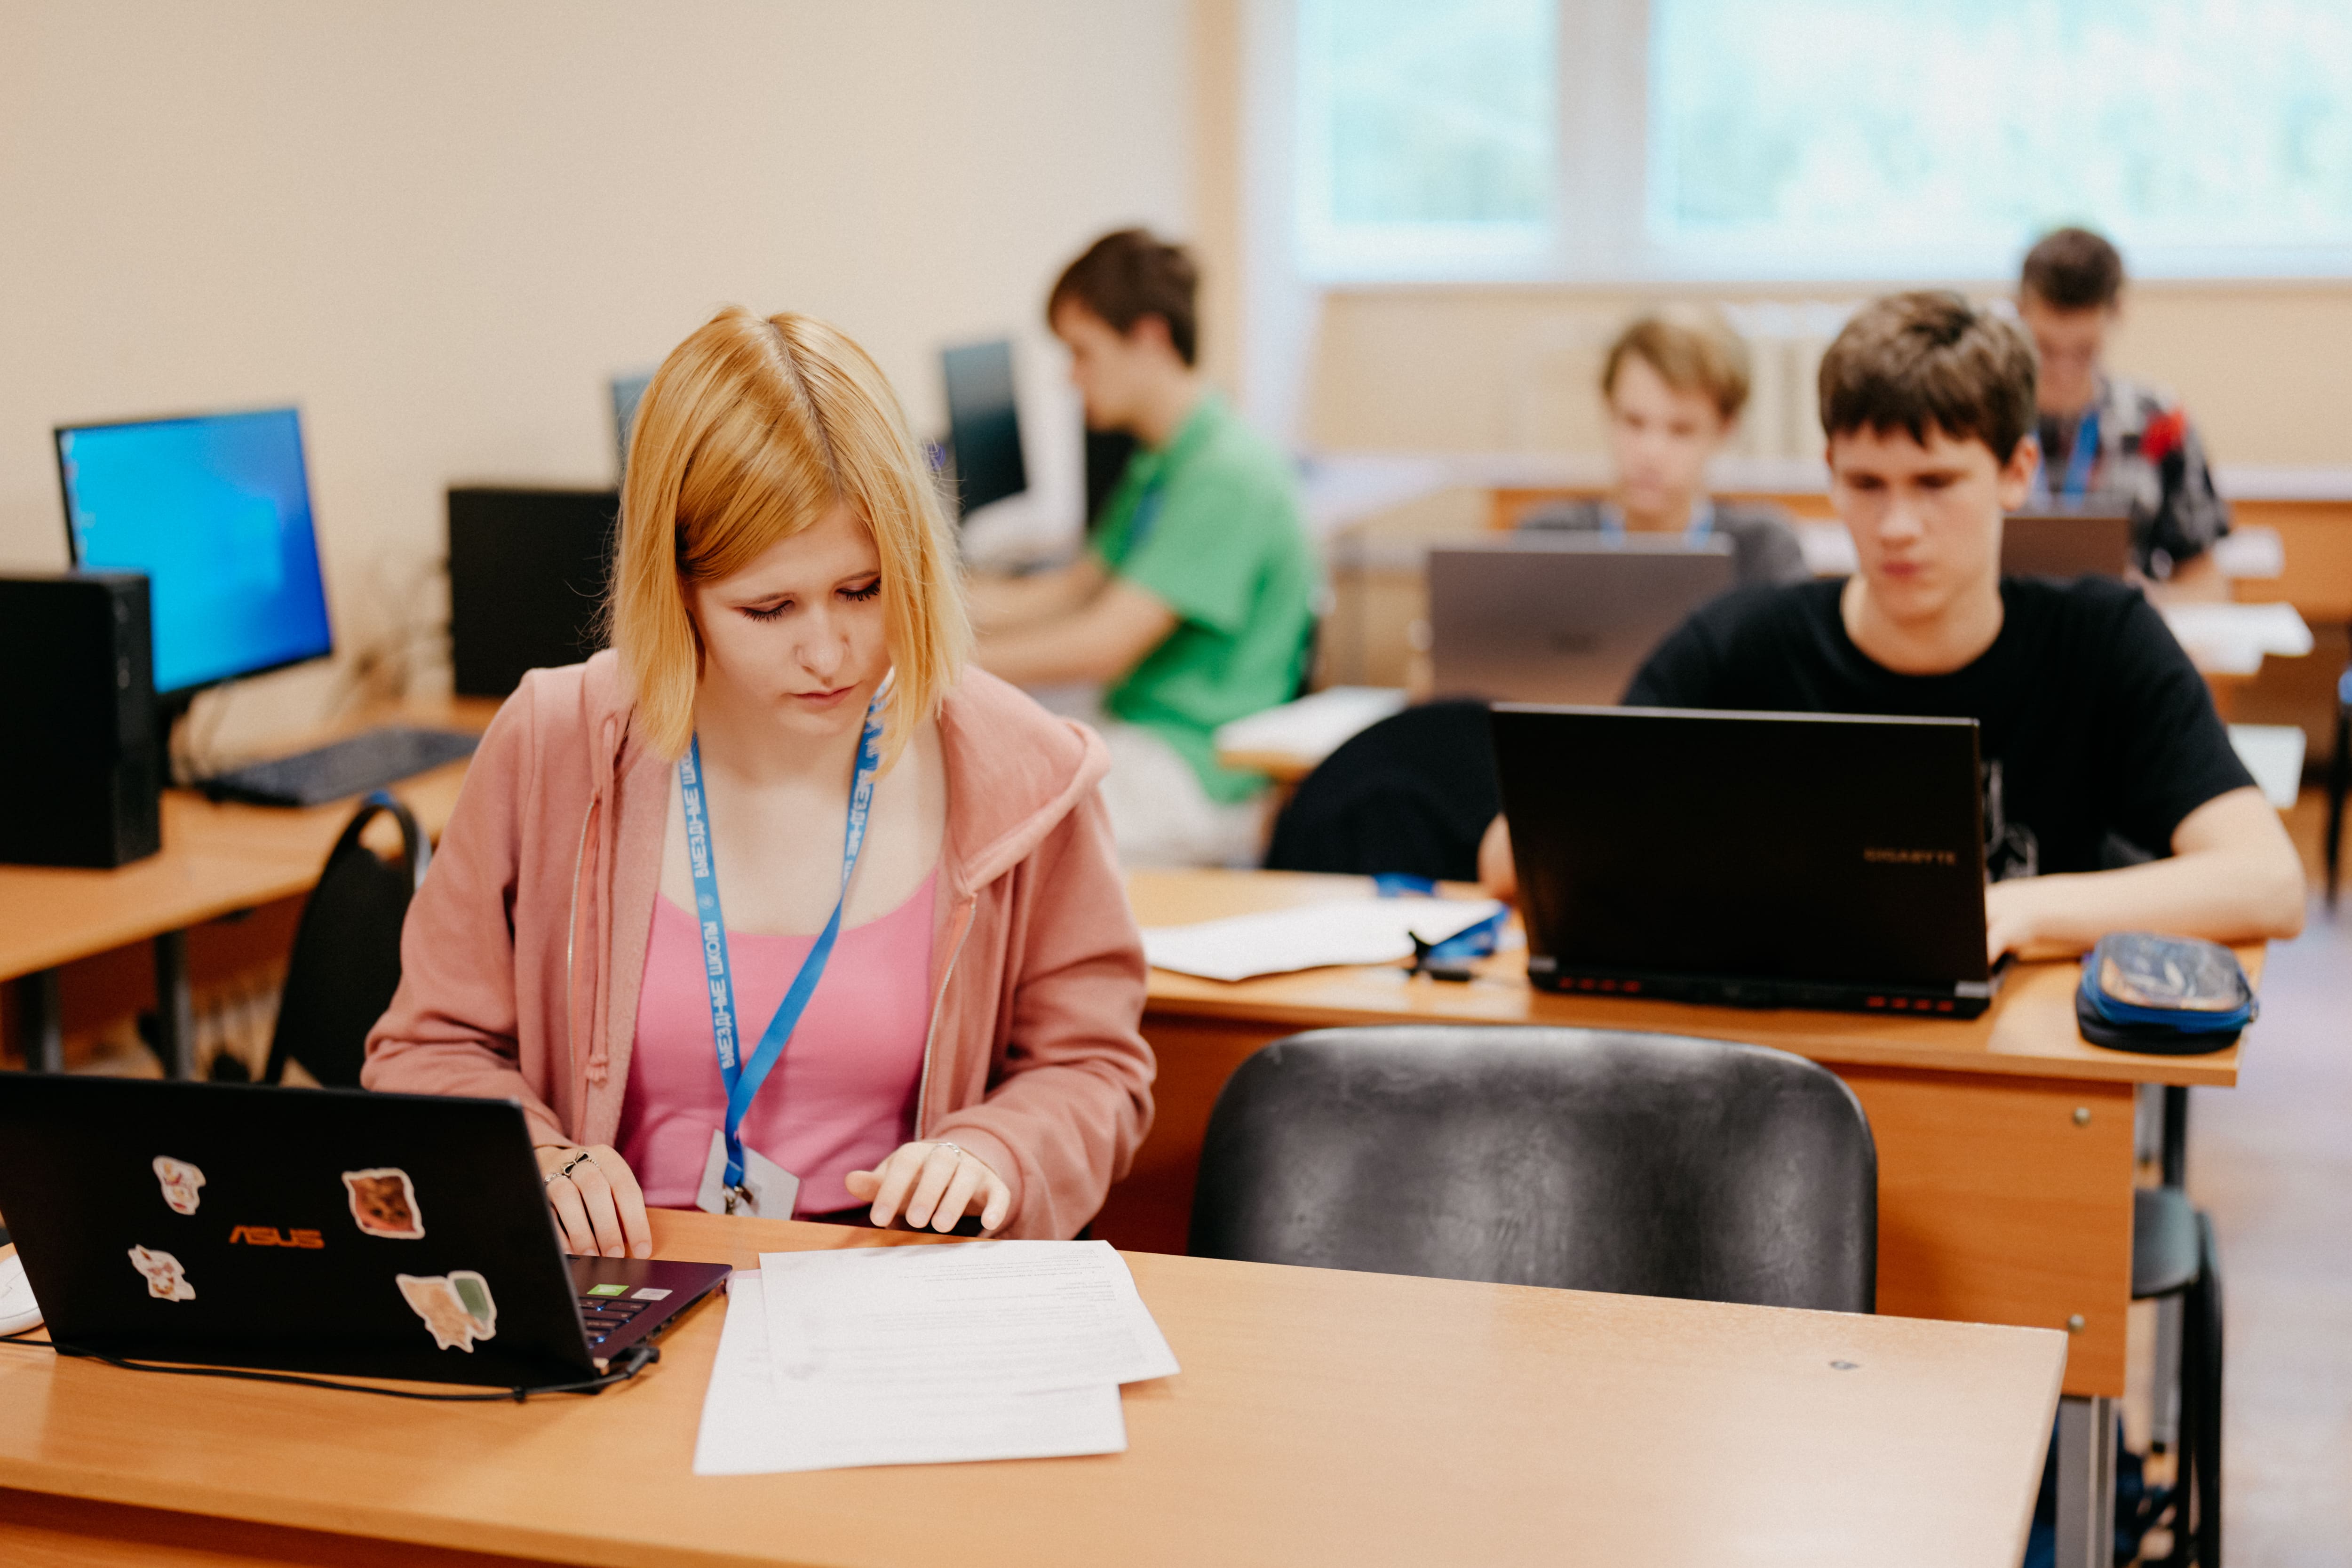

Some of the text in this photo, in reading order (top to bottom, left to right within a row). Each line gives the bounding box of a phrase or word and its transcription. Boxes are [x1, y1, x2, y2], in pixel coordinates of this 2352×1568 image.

[683, 788, 709, 878] ВЫЕЗДНЫЕ
[703, 922, 735, 1069] ВЫЕЗДНЫЕ ШКОЛЫ
[229, 1225, 326, 1250] ASUS
